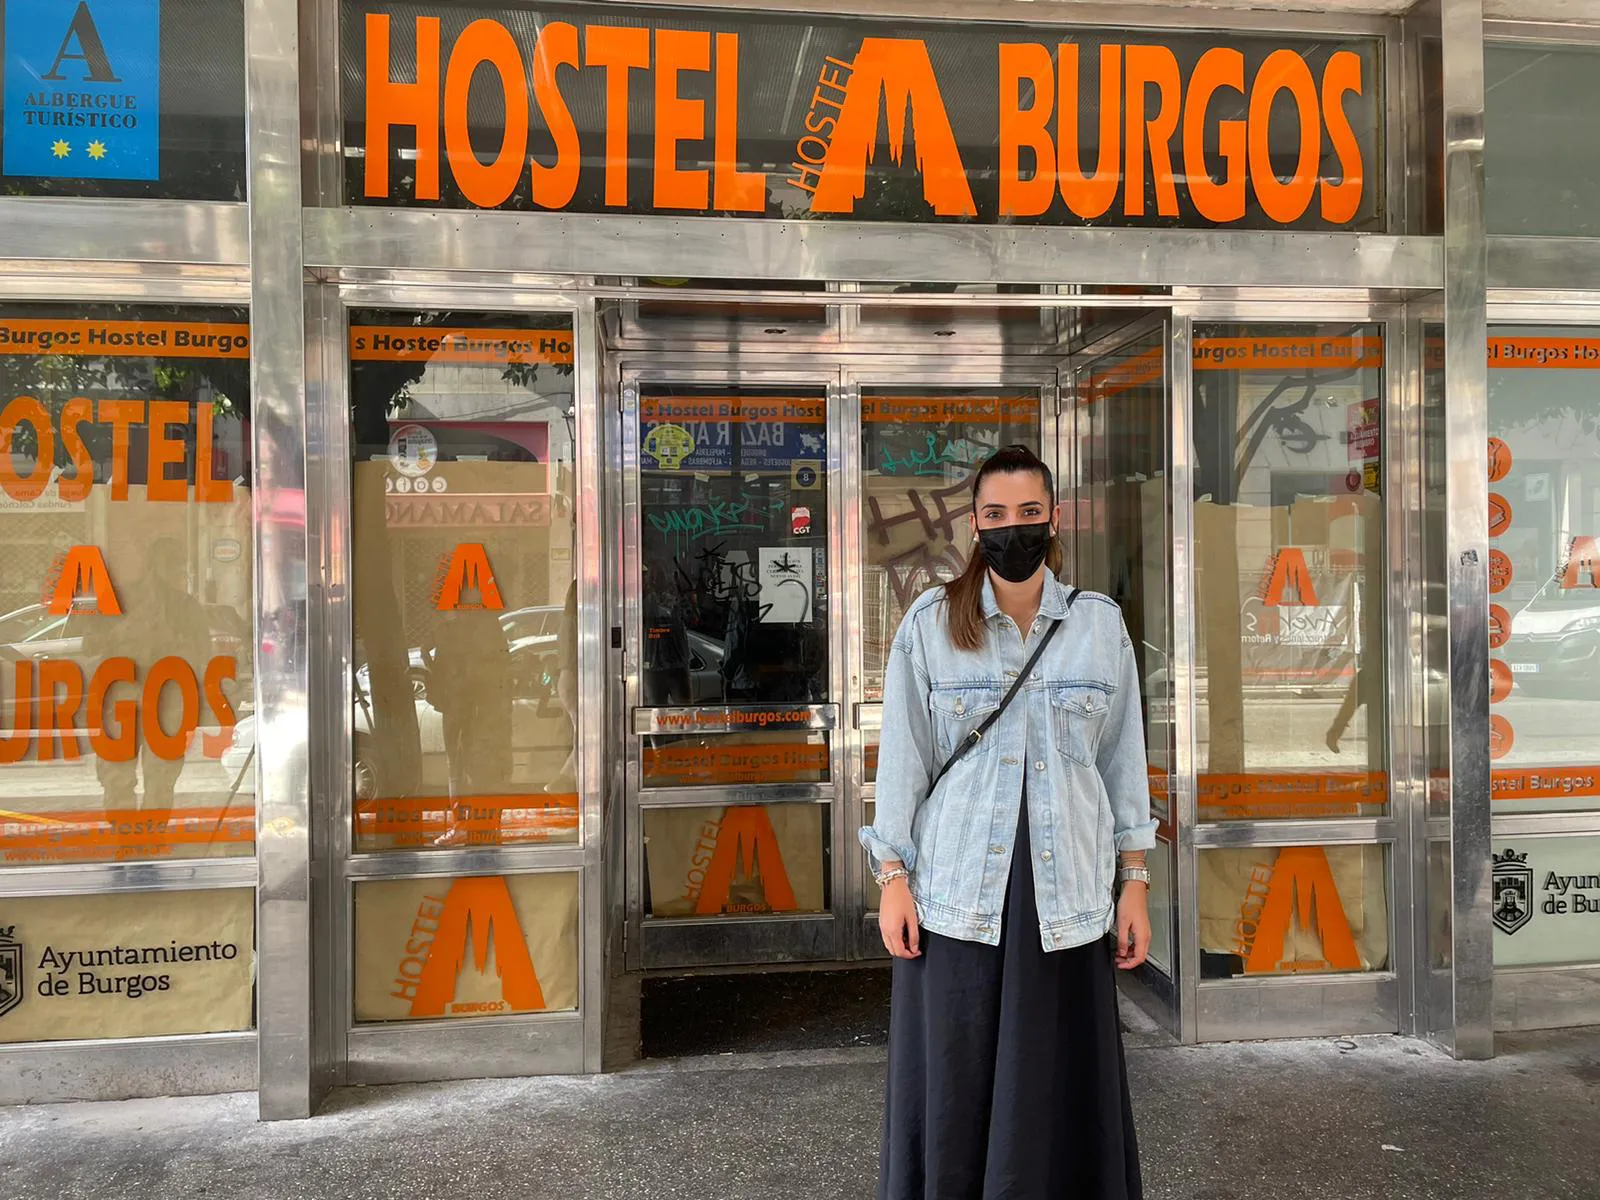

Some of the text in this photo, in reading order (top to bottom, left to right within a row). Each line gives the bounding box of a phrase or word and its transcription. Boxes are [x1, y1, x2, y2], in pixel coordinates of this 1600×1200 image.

[25, 92, 137, 110] ALBERGUE
[23, 108, 137, 129] TURÍSTICO
[365, 13, 1363, 225] HOSTEL BURGOS
[787, 55, 856, 193] HOSTEL
[88, 328, 167, 347] Hostel
[174, 330, 249, 352] Burgo
[373, 334, 446, 352] Hostel
[453, 335, 532, 358] Burgos
[1252, 343, 1315, 358] Hostel
[1504, 343, 1569, 363] Burgos
[659, 403, 714, 417] Hostel
[719, 403, 777, 419] Burgos
[880, 403, 937, 418] Burgos
[803, 473, 810, 482] 8
[792, 526, 811, 535] CGT
[1530, 774, 1594, 793] Burgos
[681, 817, 725, 901] HOSTEL
[1231, 862, 1274, 958] HOSTEL
[1543, 893, 1567, 914] de
[38, 940, 237, 974] Ayuntamiento
[391, 895, 445, 1001] HOSTEL
[38, 971, 170, 998] de Burgos
[451, 1000, 505, 1014] BURGOS
